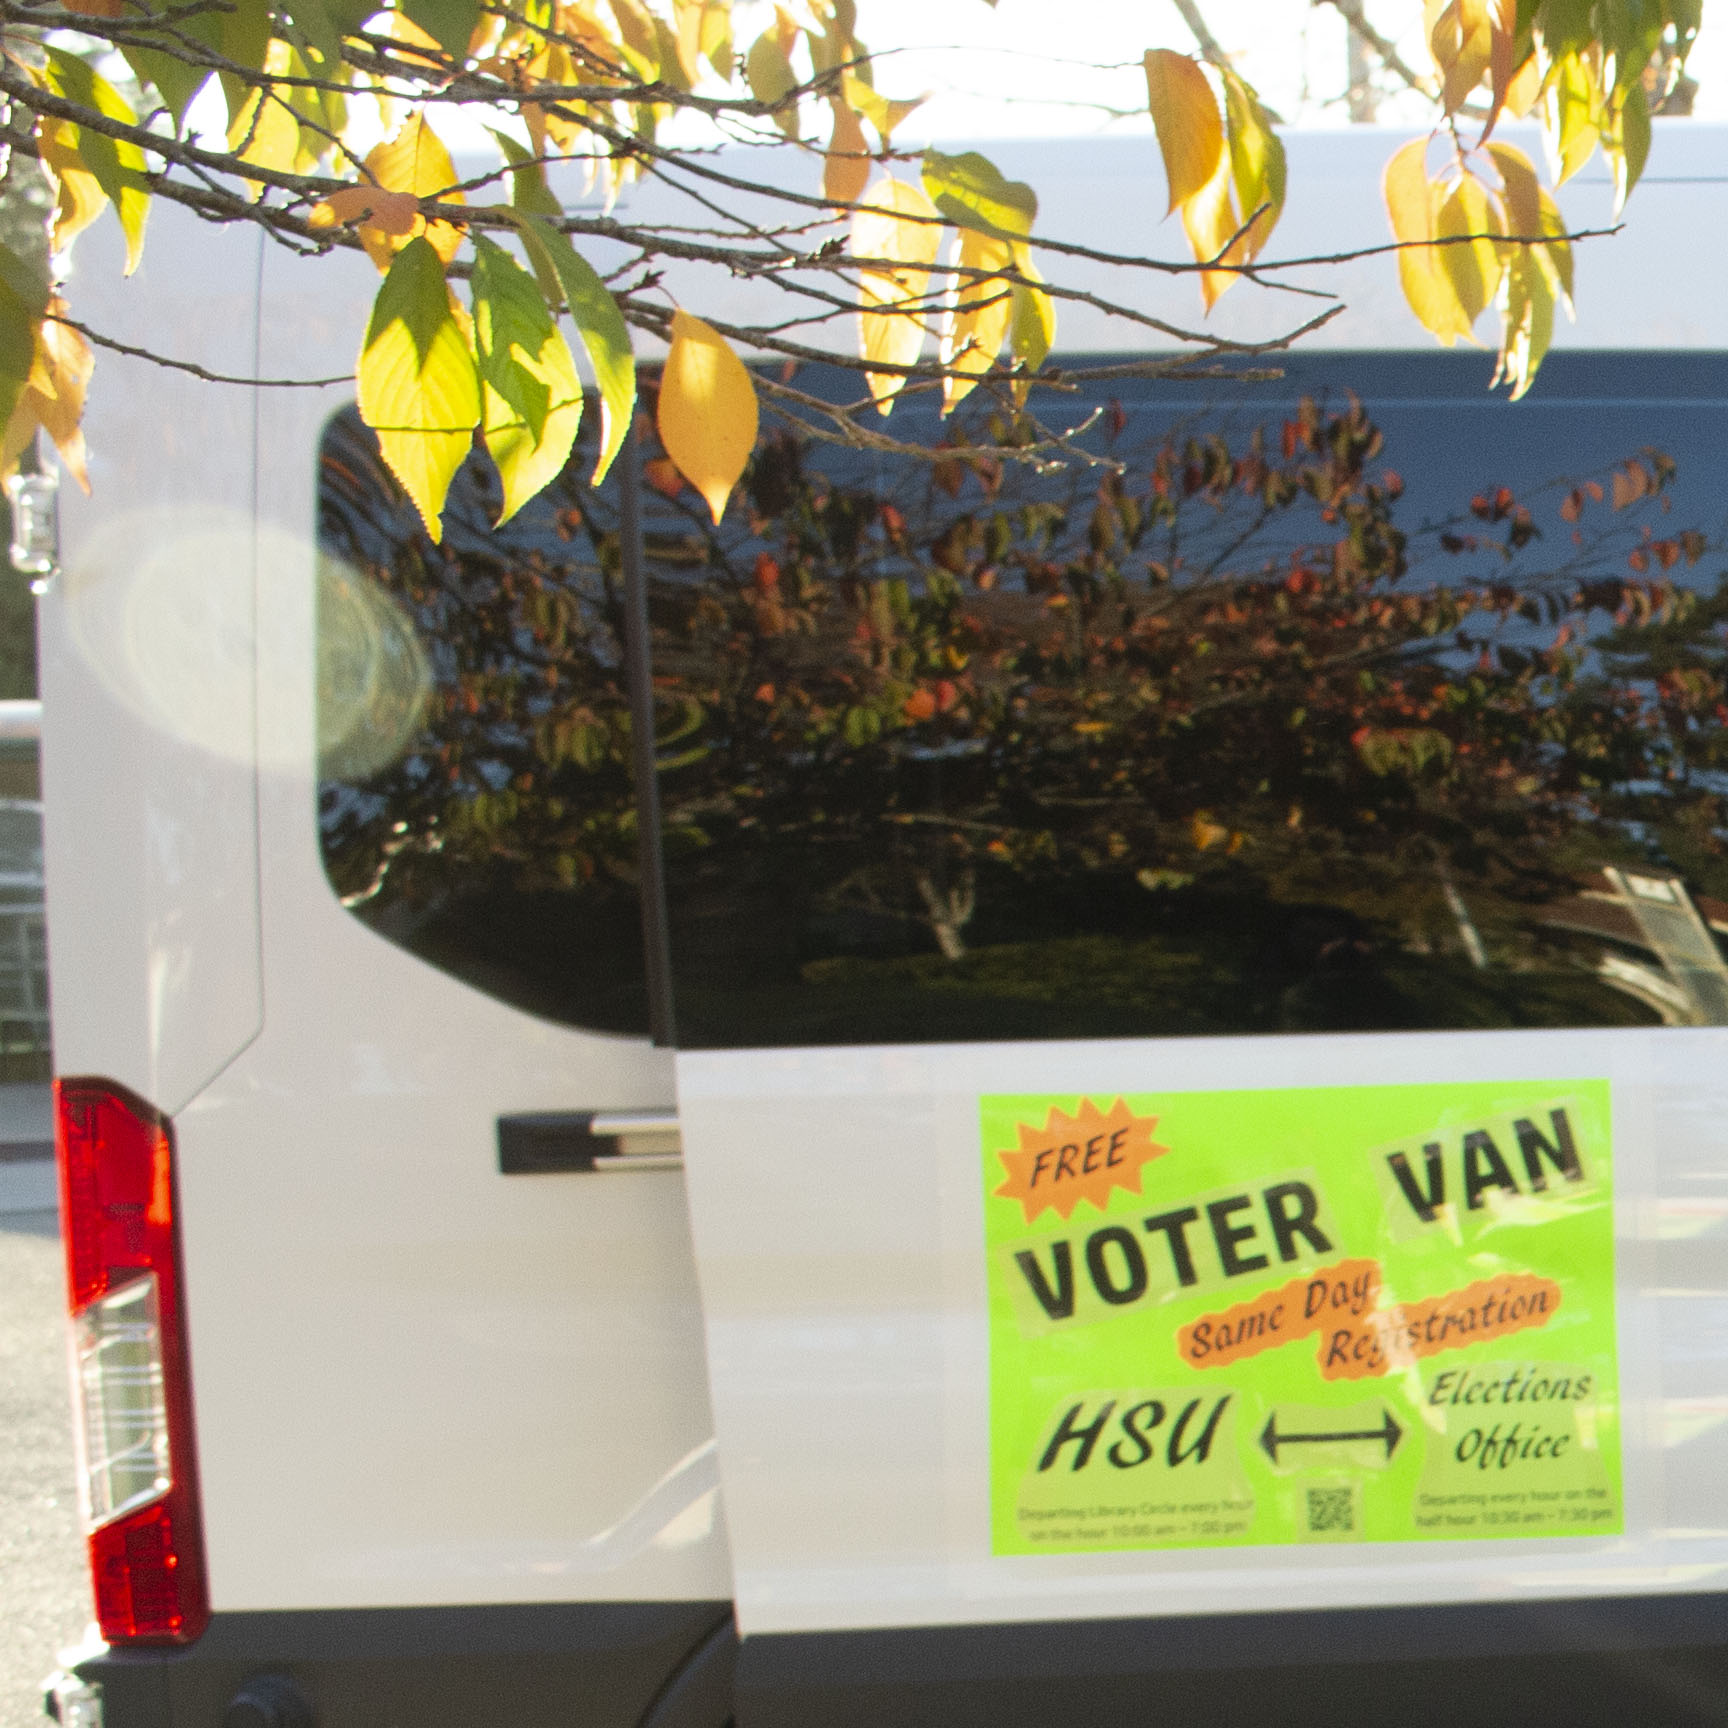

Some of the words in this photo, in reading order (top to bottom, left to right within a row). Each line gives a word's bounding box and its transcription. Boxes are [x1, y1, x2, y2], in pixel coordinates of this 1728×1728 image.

[1029, 1127, 1129, 1188] FREE
[1015, 1180, 1333, 1320] VOTER
[1386, 1107, 1584, 1224] VAN
[1190, 1305, 1284, 1359] Same
[1304, 1272, 1370, 1316] Day
[1429, 1368, 1591, 1405] Elections
[1037, 1394, 1232, 1474] HSU
[1455, 1423, 1570, 1470] Office
